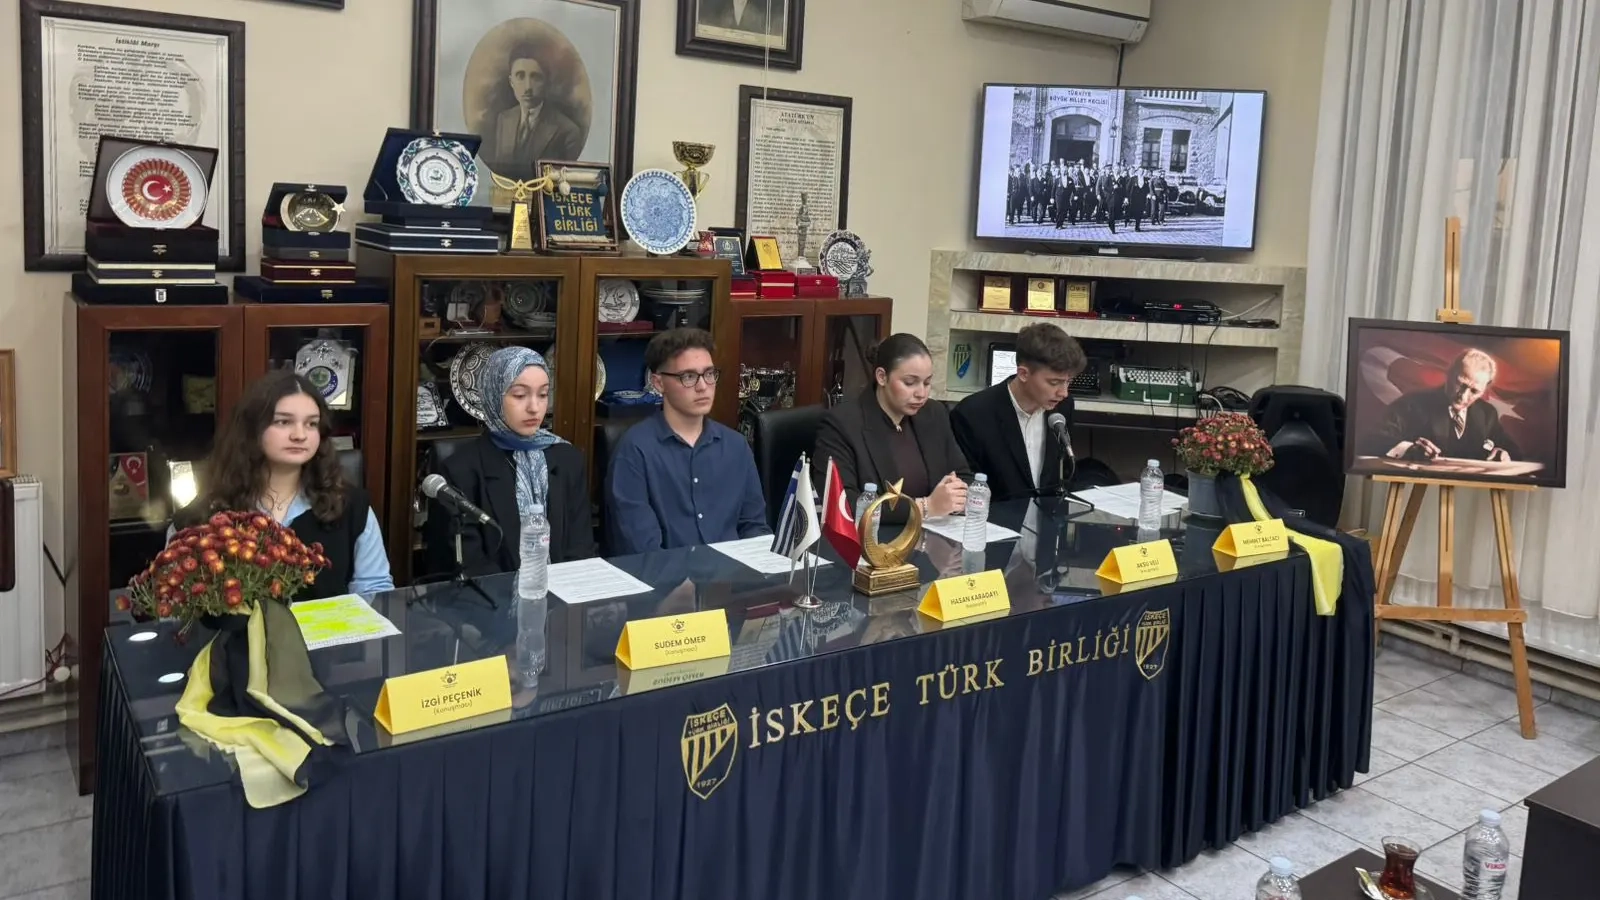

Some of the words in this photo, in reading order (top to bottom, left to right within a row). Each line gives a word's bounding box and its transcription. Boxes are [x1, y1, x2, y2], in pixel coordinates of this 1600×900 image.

[556, 202, 592, 217] TÜRK
[950, 594, 971, 605] HASAN
[970, 590, 999, 602] KARADAYI
[654, 639, 683, 650] SUDEM
[683, 635, 706, 645] ÖMER
[748, 682, 892, 750] İSKEÇE
[916, 657, 1005, 706] TÜRK
[1026, 623, 1130, 677] BİRLİĞİ
[420, 694, 441, 709] İZGİ
[442, 686, 482, 704] PEÇENİK
[697, 778, 717, 789] 1927
